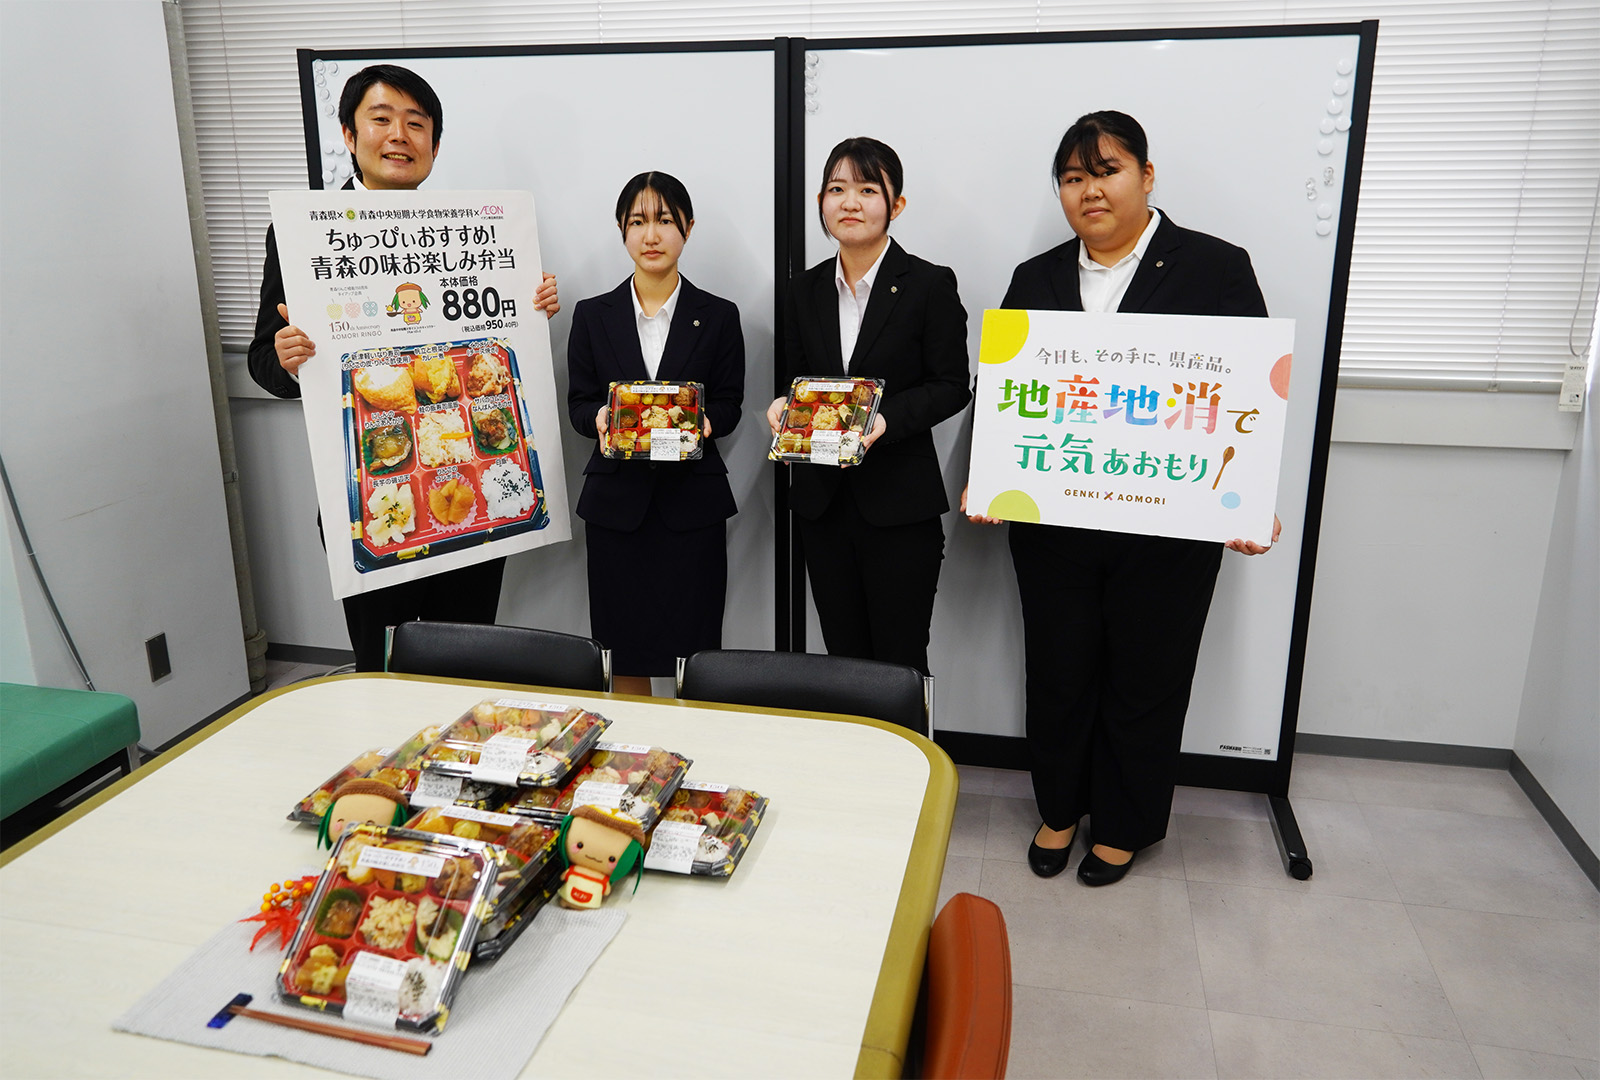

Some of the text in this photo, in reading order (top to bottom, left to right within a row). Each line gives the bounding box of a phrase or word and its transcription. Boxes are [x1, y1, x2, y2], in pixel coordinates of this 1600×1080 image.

[311, 247, 516, 280] 青森の味お楽しみ弁当
[440, 275, 478, 287] 本体価格
[442, 286, 516, 321] 880円
[331, 330, 383, 340] AOMORI RINGO
[351, 348, 401, 361] 新津軽いなり寿司
[422, 352, 445, 361] カレー煮
[997, 373, 1260, 435] 地産地消で
[436, 465, 458, 476] りんごの
[435, 472, 461, 483] コンポート
[1064, 488, 1100, 499] GENKI
[1117, 493, 1166, 505] AOMORI
